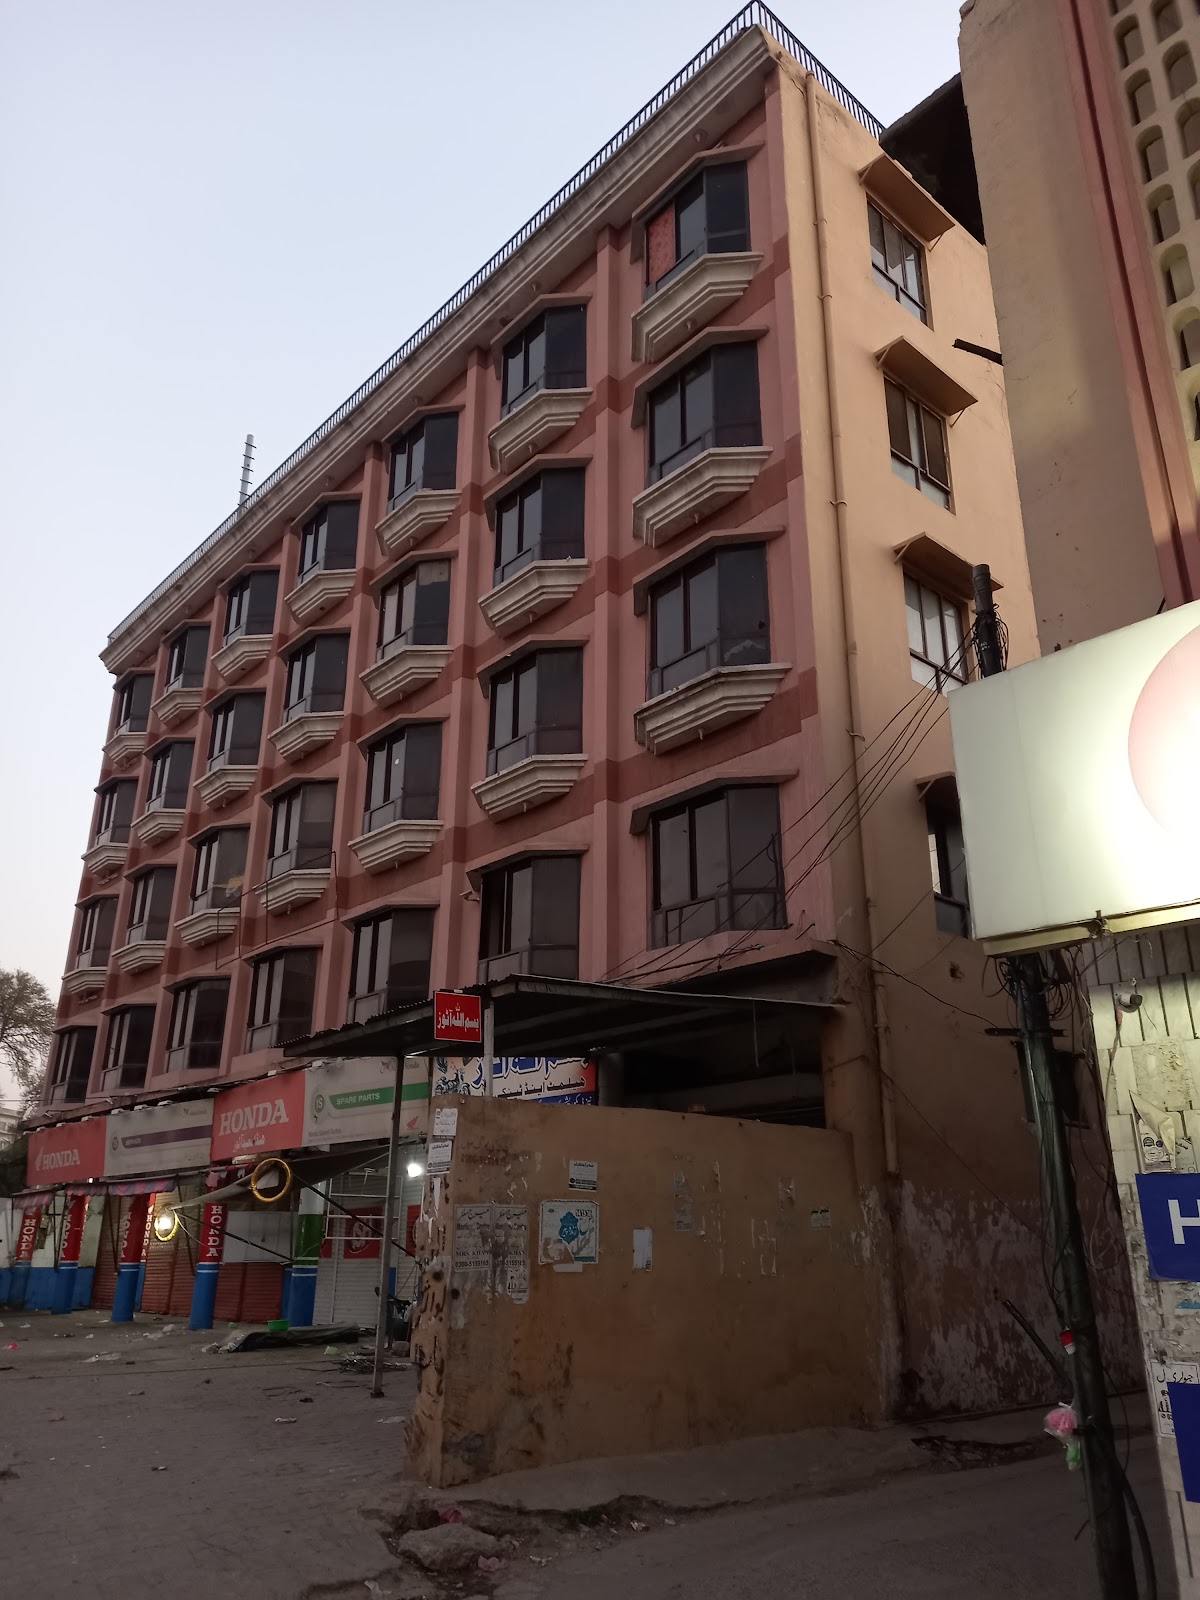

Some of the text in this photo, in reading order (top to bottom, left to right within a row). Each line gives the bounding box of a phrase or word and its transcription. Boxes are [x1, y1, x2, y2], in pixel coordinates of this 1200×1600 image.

[437, 1008, 453, 1030] آٹوز
[465, 1016, 479, 1032] بسم
[336, 1092, 380, 1106] SPARE PARTS
[218, 1098, 289, 1137] HONDA
[124, 1137, 141, 1146] SERVICE
[41, 1148, 80, 1171] HONDA
[19, 1218, 37, 1258] HONDA
[140, 1214, 153, 1257] HONDA
[205, 1205, 223, 1257] HONDA
